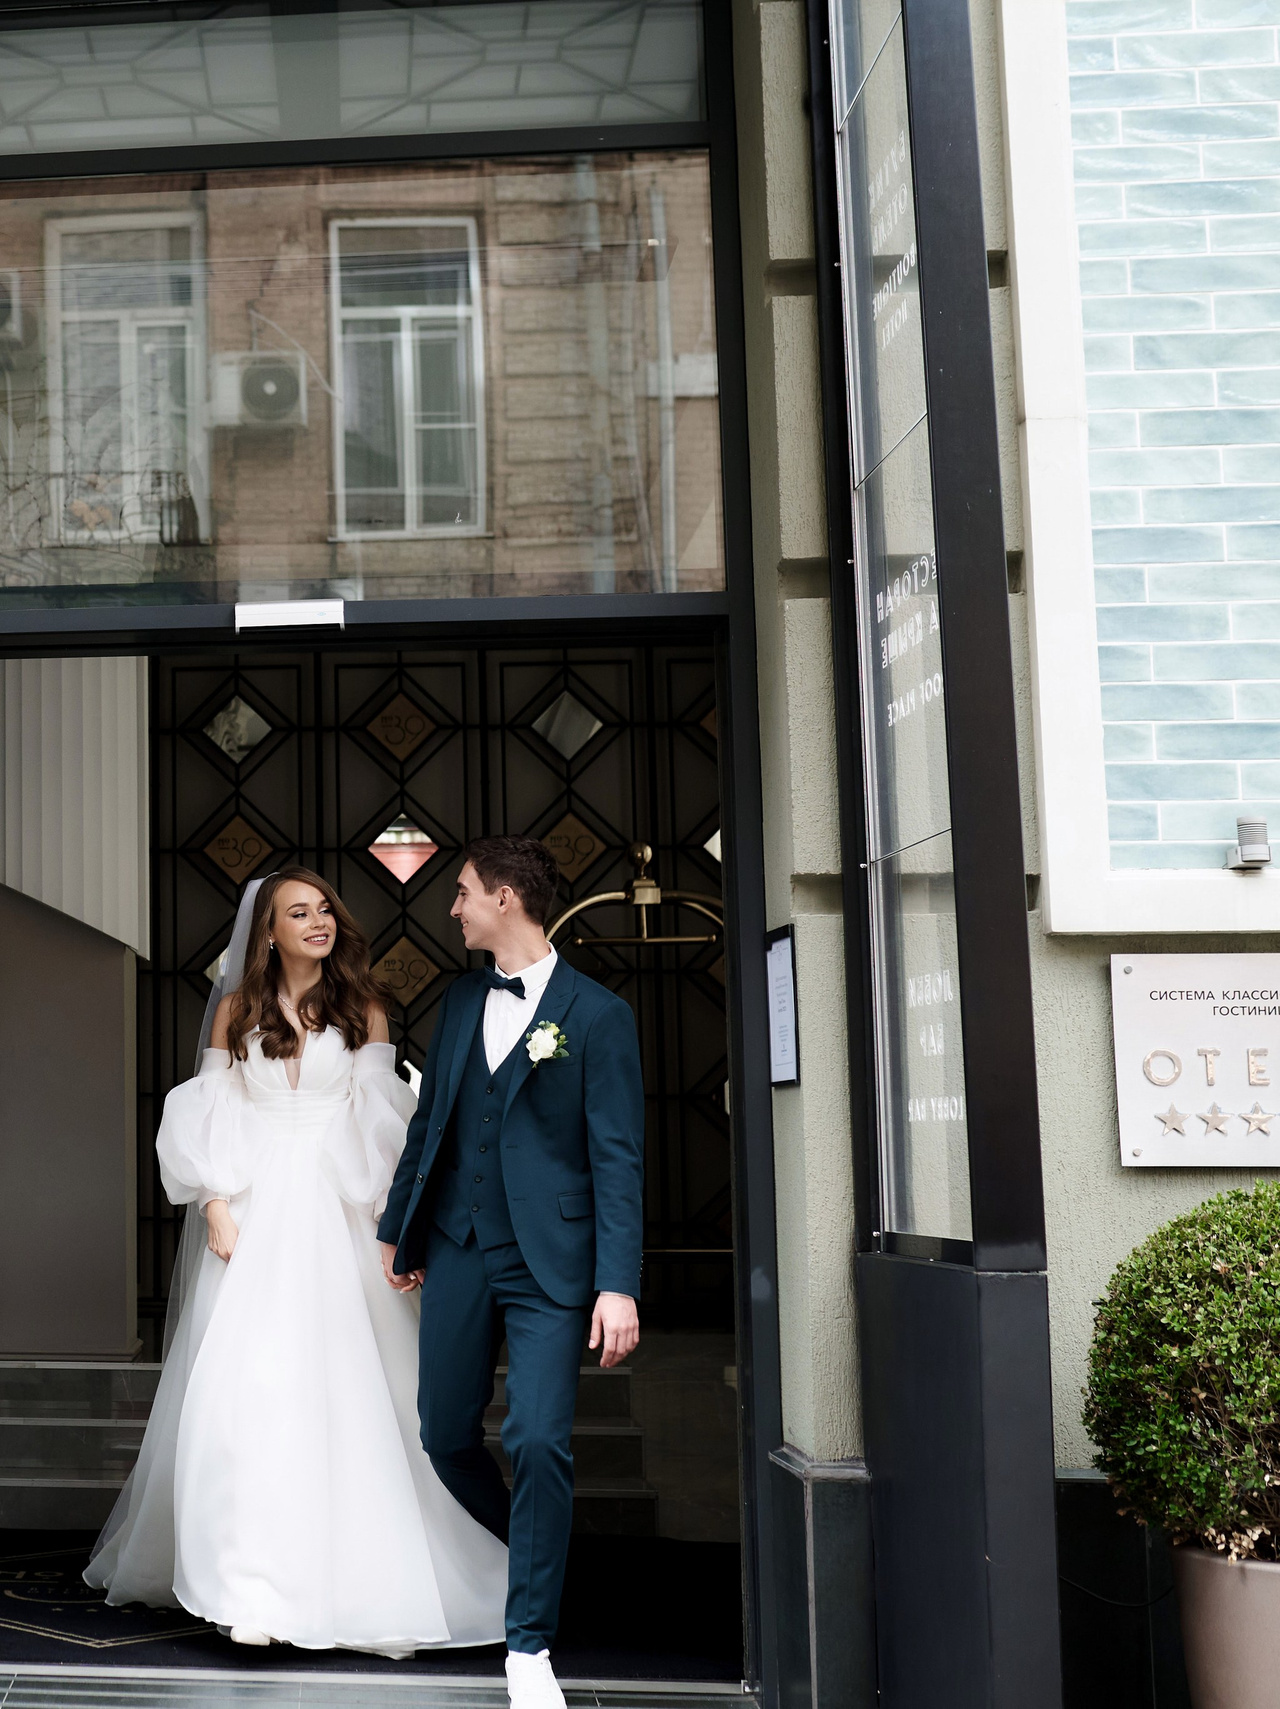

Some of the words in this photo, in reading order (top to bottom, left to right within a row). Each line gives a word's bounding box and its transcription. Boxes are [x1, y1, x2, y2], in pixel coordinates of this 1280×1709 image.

[1149, 990, 1215, 1000] СИСТЕМА
[1222, 990, 1280, 1001] КЛАССИ
[1213, 1005, 1280, 1016] ГОСТИНИ
